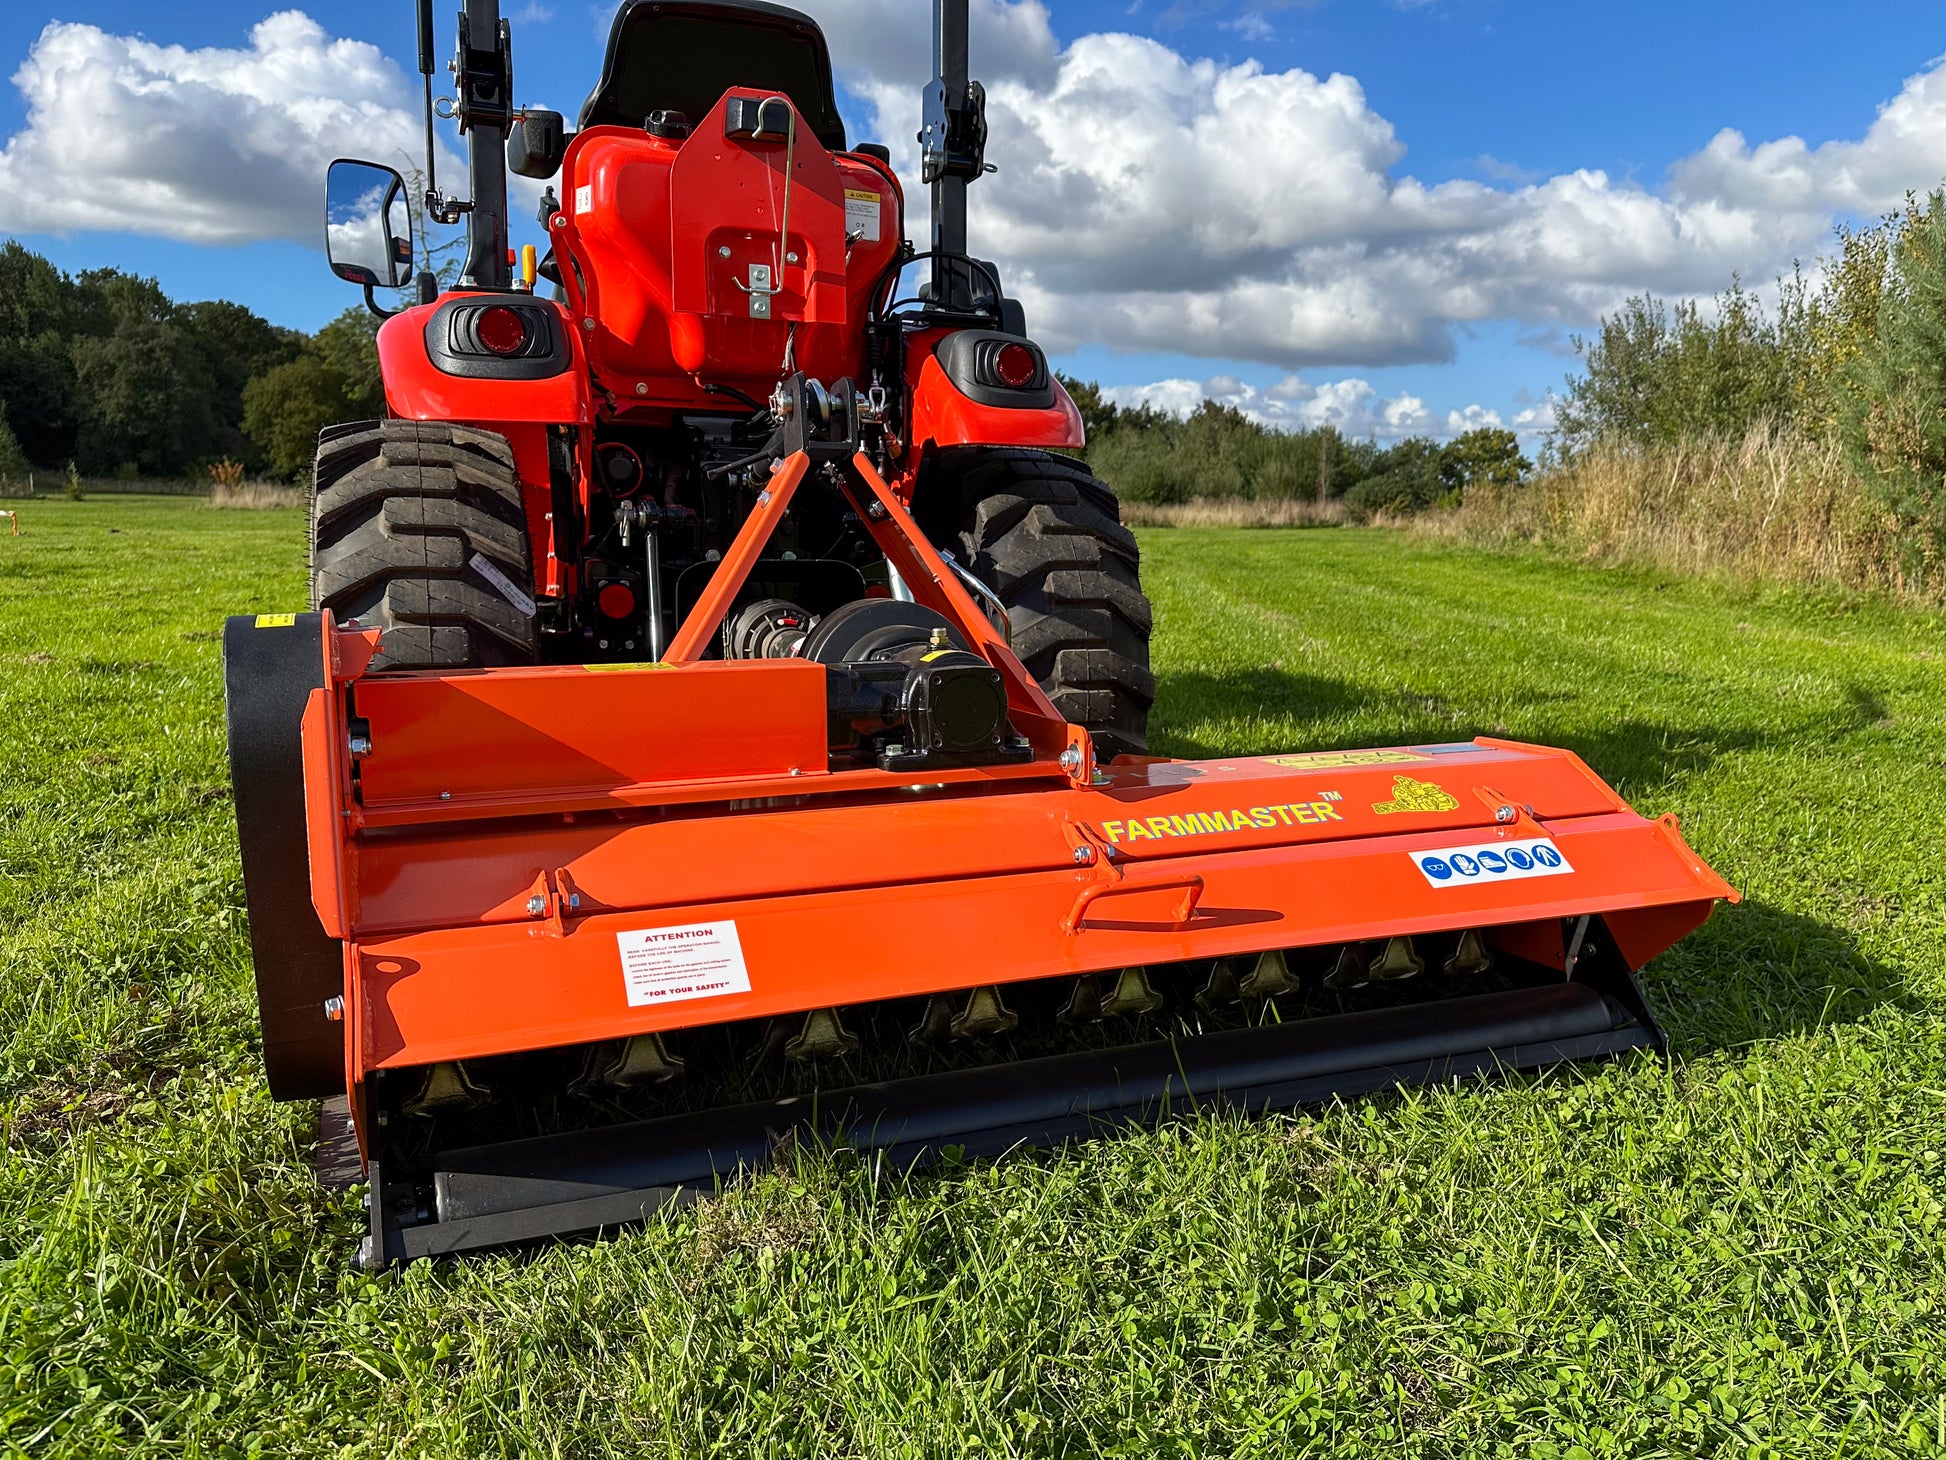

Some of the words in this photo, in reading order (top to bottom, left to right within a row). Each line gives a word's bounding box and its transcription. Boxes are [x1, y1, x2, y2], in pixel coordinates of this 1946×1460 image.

[1102, 801, 1344, 843] FARMMASTER
[645, 929, 714, 943] ATTENTION
[669, 986, 693, 995] YOUR
